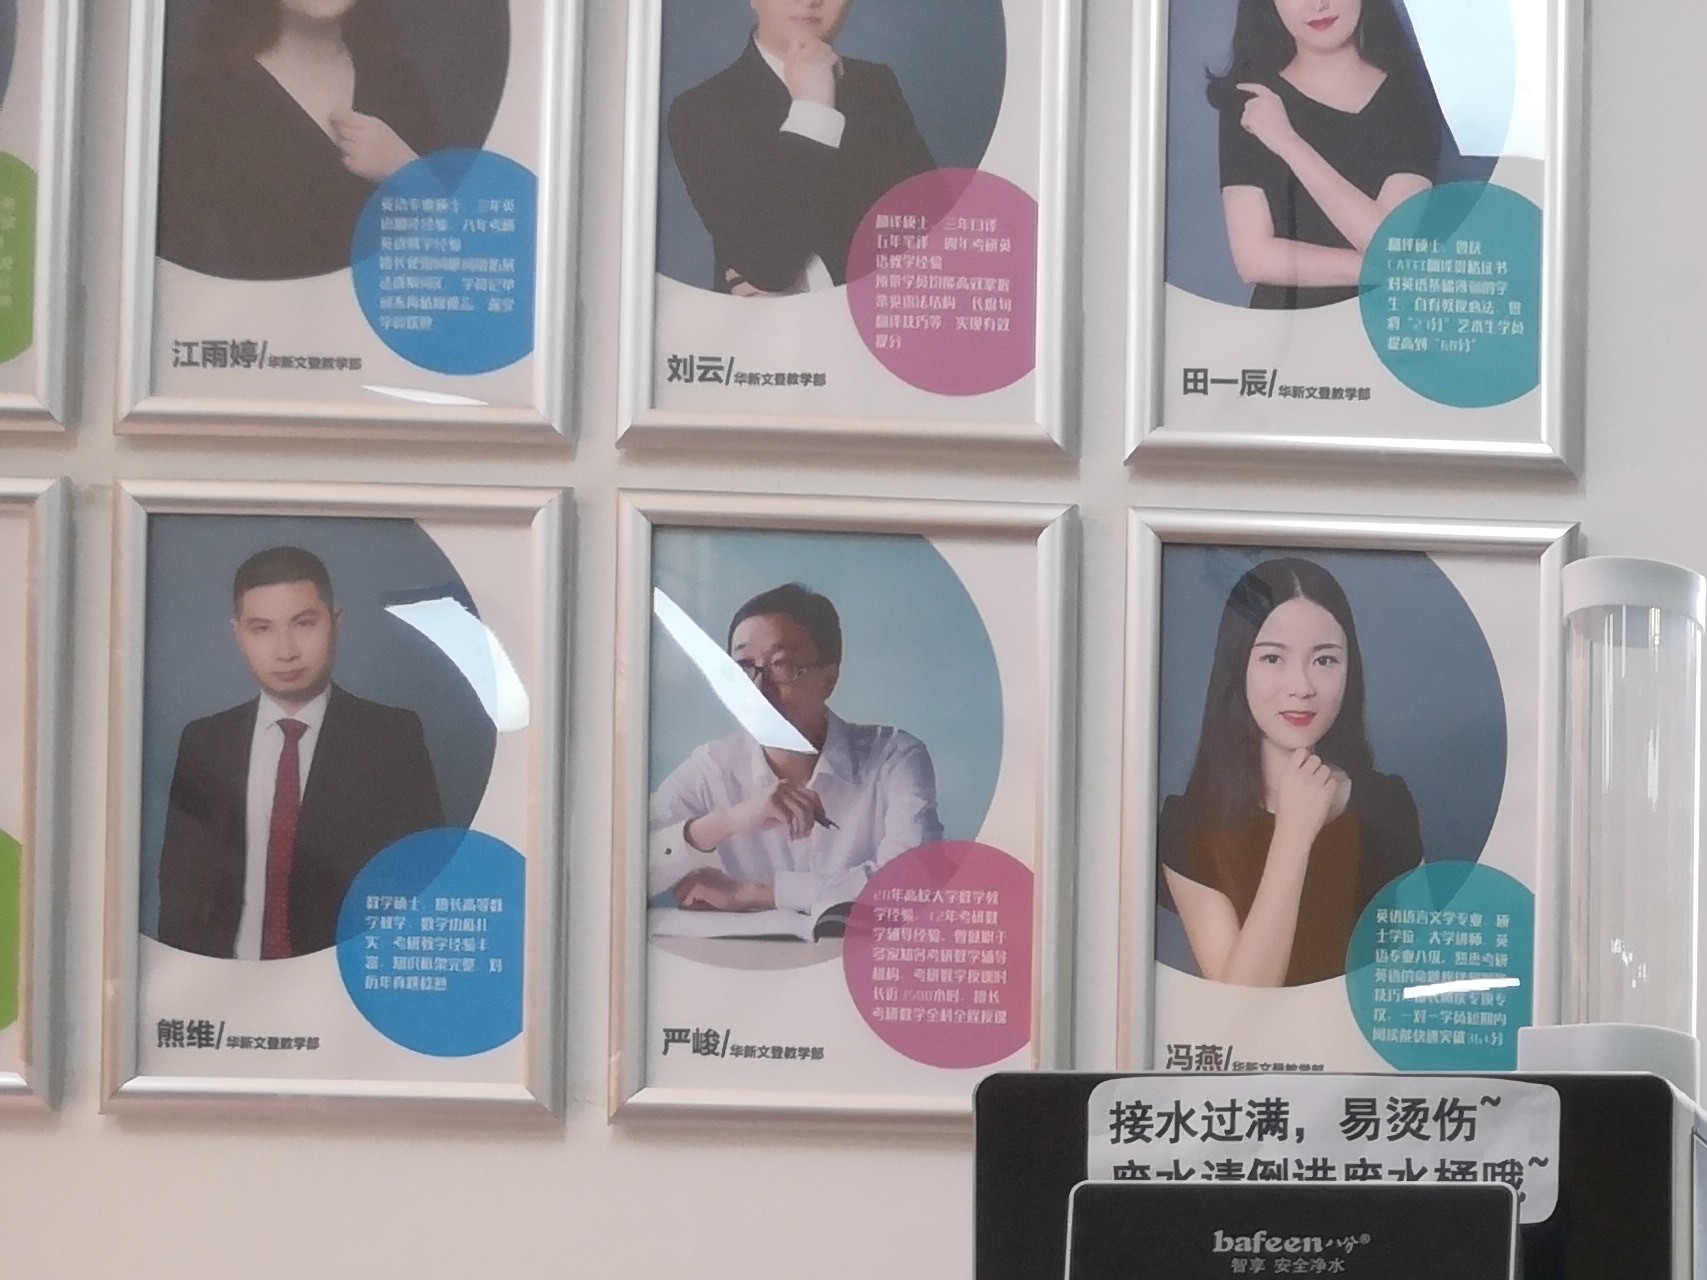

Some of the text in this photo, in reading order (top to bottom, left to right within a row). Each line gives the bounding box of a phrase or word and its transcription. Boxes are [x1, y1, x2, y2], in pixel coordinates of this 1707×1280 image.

[1212, 1230, 1323, 1253] bafeen
[1231, 1258, 1345, 1273] 智享 安全净水
